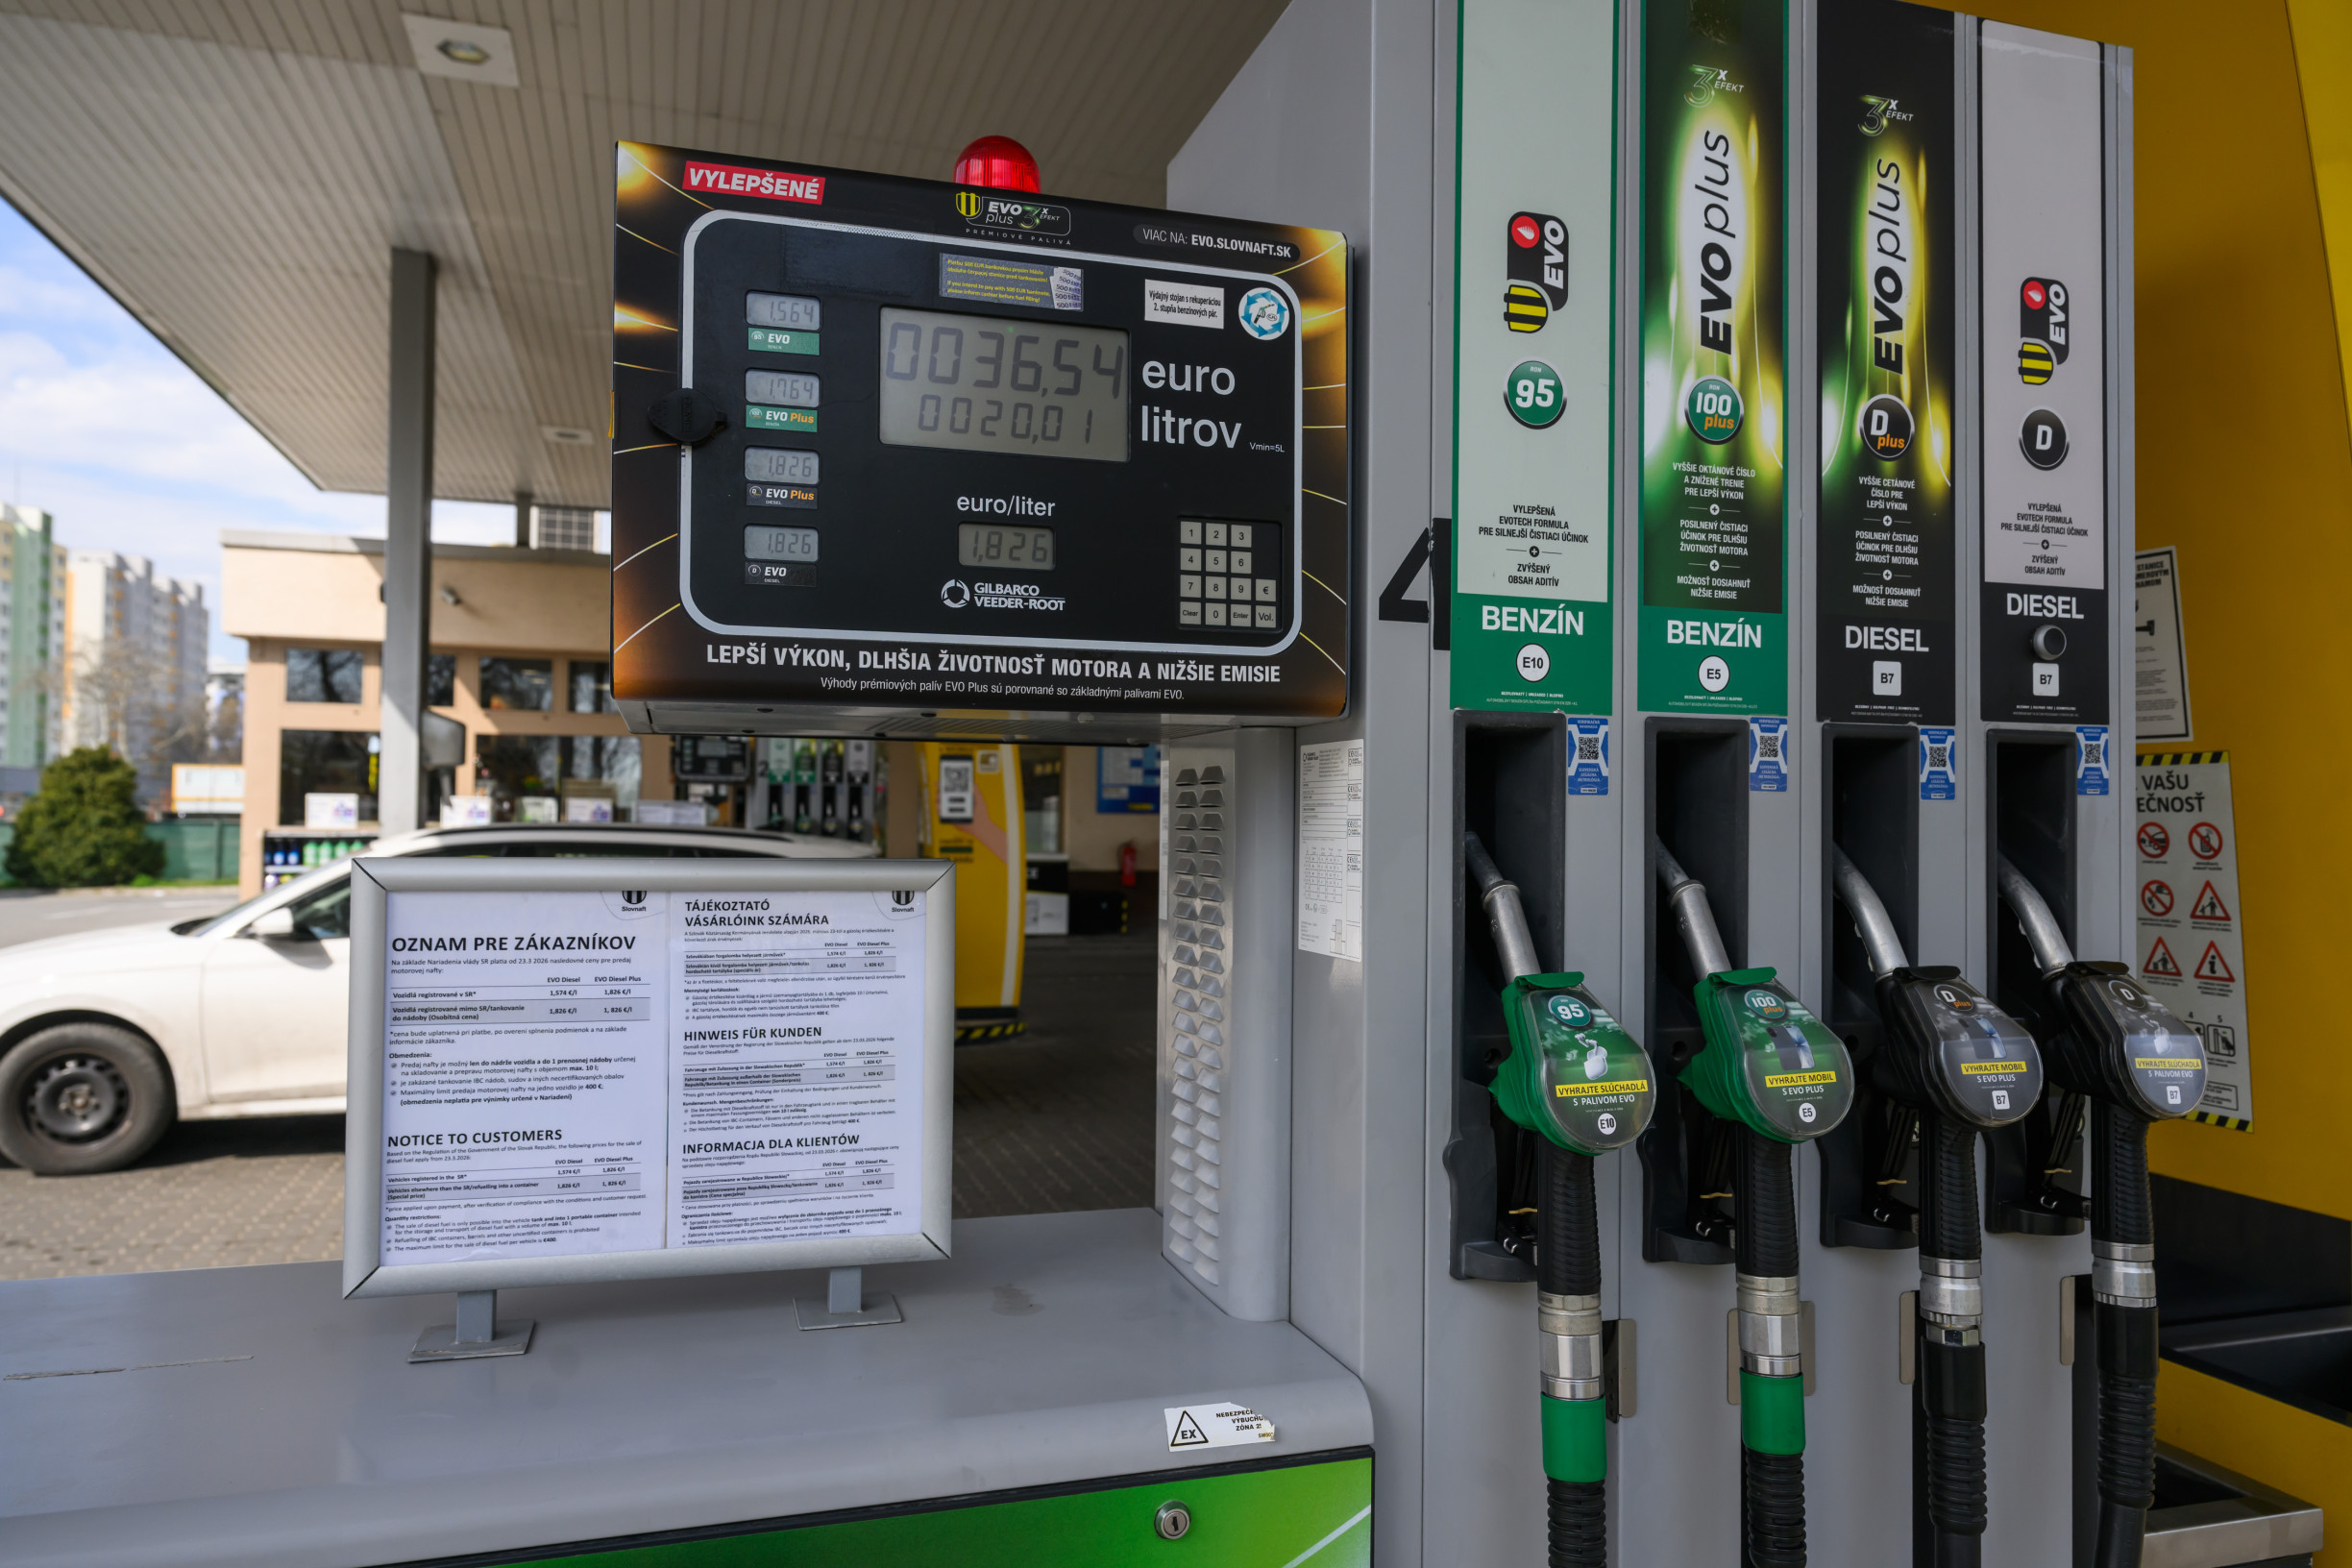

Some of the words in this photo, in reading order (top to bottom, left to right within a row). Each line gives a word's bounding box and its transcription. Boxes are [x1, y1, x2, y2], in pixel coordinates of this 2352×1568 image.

[1714, 80, 1744, 93] EFEKT
[1886, 110, 1914, 122] EFEKT
[690, 168, 819, 200] VYLEPŠENÉ
[1695, 130, 1736, 239] plus
[989, 202, 1022, 214] EVO
[1869, 158, 1906, 263] plus
[986, 213, 1013, 224] plus
[967, 228, 1022, 239] PRÉMIOVÉ
[1031, 235, 1070, 245] PALIVÁ
[1143, 228, 1166, 241] VIAC
[1170, 233, 1188, 244] NA:
[1191, 234, 1291, 257] EVO.SLOVNAFT.SK
[1544, 220, 1564, 289] EVO
[1149, 290, 1168, 301] Výdajný
[1170, 293, 1185, 303] stojan
[1189, 296, 1220, 307] rekuperáciou
[1701, 242, 1731, 355] EVO
[770, 302, 814, 323] 1,564
[1161, 304, 1176, 314] stupňa
[1209, 308, 1217, 318] pár.
[2049, 283, 2066, 346] EVO
[1874, 266, 1903, 375] EVO
[769, 333, 790, 344] EVO
[886, 322, 1123, 399] 0036,54
[1142, 359, 1236, 395] euro
[770, 379, 813, 400] 1,764
[1515, 379, 1555, 407] 95
[1696, 392, 1731, 416] 100
[766, 411, 788, 421] EVO
[791, 413, 814, 423] Plus
[919, 394, 1092, 444] 0020,01
[1704, 414, 1734, 430] plus
[1871, 409, 1889, 436] D
[1142, 404, 1241, 449] litrov
[1249, 442, 1285, 453] Vmin=5L
[1877, 433, 1905, 450] plus
[2036, 426, 2052, 450] D
[770, 455, 811, 477] 1,826
[1673, 462, 1697, 473] VYŠŠIE
[1699, 463, 1735, 476] OKTÁNOVÉ
[1736, 466, 1755, 478] ČÍSLO
[1691, 474, 1718, 486] ZNÍŽENÉ
[1721, 478, 1745, 488] TRENIE
[766, 488, 788, 498] EVO
[791, 490, 814, 500] Plus
[1684, 487, 1698, 496] PRE
[1700, 485, 1719, 497] LEPŠÍ
[1720, 487, 1744, 500] VÝKON
[957, 496, 1055, 517] euro/liter
[1513, 503, 1556, 517] VYLEPŠENÁ
[1499, 516, 1531, 527] EVOTECH
[1533, 518, 1569, 529] FORMULA
[769, 533, 811, 553] 1,826
[1479, 527, 1493, 536] PRE
[1495, 527, 1528, 539] SILNEJŠÍ
[1529, 528, 1559, 541] ČISTIACI
[1561, 530, 1589, 544] ÚČINOK
[972, 530, 1048, 563] 1,826
[765, 567, 786, 576] EVO
[1517, 561, 1550, 574] ZVÝŠENÝ
[1379, 517, 1452, 650] 4
[1507, 575, 1533, 585] OBSAH
[1535, 575, 1559, 587] ADITÍV
[974, 582, 1040, 597] GILBARCO
[974, 597, 1066, 611] VEEDER-ROOT
[2007, 593, 2084, 619] DIESEL
[1482, 603, 1583, 636] BENZÍN
[1667, 617, 1761, 648] BENZÍN
[1846, 625, 1929, 652] DIESEL
[707, 642, 766, 665] LEPŠÍ
[774, 644, 850, 671] VÝKON,
[859, 649, 931, 671] DLHŠIA
[939, 649, 1044, 675] ŽIVOTNOSŤ
[1052, 658, 1132, 679] MOTORA
[1139, 662, 1151, 679] A
[1158, 660, 1214, 681] NIŽŠIE
[1221, 664, 1280, 682] EMISIE
[1523, 656, 1544, 669] E10
[1706, 669, 1721, 679] E5
[1880, 673, 1895, 684] B7
[2039, 674, 2053, 685] B7
[821, 676, 857, 690] Výhody
[860, 678, 917, 692] prémiových
[919, 680, 942, 693] palív
[944, 681, 965, 692] EVO
[968, 683, 988, 693] Plus
[991, 684, 1002, 694] sú
[1005, 685, 1053, 696] porovnané
[1057, 687, 1067, 696] so
[1070, 686, 1121, 698] základnými
[1124, 688, 1161, 699] palivami
[1164, 689, 1184, 700] EVO.
[2142, 771, 2189, 790] VAŠU
[685, 898, 770, 912] TÁJÉKOZTATÓ
[685, 915, 764, 926] VÁSÁRLÓINK
[769, 914, 828, 925] SZÁMÁRA
[392, 937, 466, 951] OZNAM
[474, 937, 508, 951] PRE
[514, 933, 636, 951] ZÁKAZNÍKOV
[1752, 997, 1776, 1007] 100
[1557, 1004, 1584, 1019] 95
[1763, 1006, 1783, 1015] plus
[684, 1030, 739, 1041] HINWEIS
[743, 1027, 766, 1039] FÜR
[771, 1026, 821, 1038] KUNDEN
[1769, 1075, 1806, 1086] VYHRAJTE
[1809, 1073, 1833, 1082] MOBIL
[1558, 1086, 1599, 1095] VYHRAJTE
[1601, 1081, 1646, 1093] SLÚCHADLÁ
[1789, 1087, 1803, 1095] EVO
[2169, 1090, 2178, 1099] B7
[1581, 1095, 1618, 1105] PALIVOM
[1619, 1094, 1634, 1103] EVO
[1802, 1108, 1812, 1117] E5
[1601, 1118, 1614, 1129] E10
[387, 1134, 443, 1148] NOTICE
[448, 1134, 467, 1145] TO
[473, 1129, 562, 1143] CUSTOMERS
[683, 1139, 765, 1154] INFORMACJA
[769, 1139, 793, 1149] DLA
[796, 1133, 859, 1147] KLIENTÓW
[1181, 1430, 1196, 1439] EX
